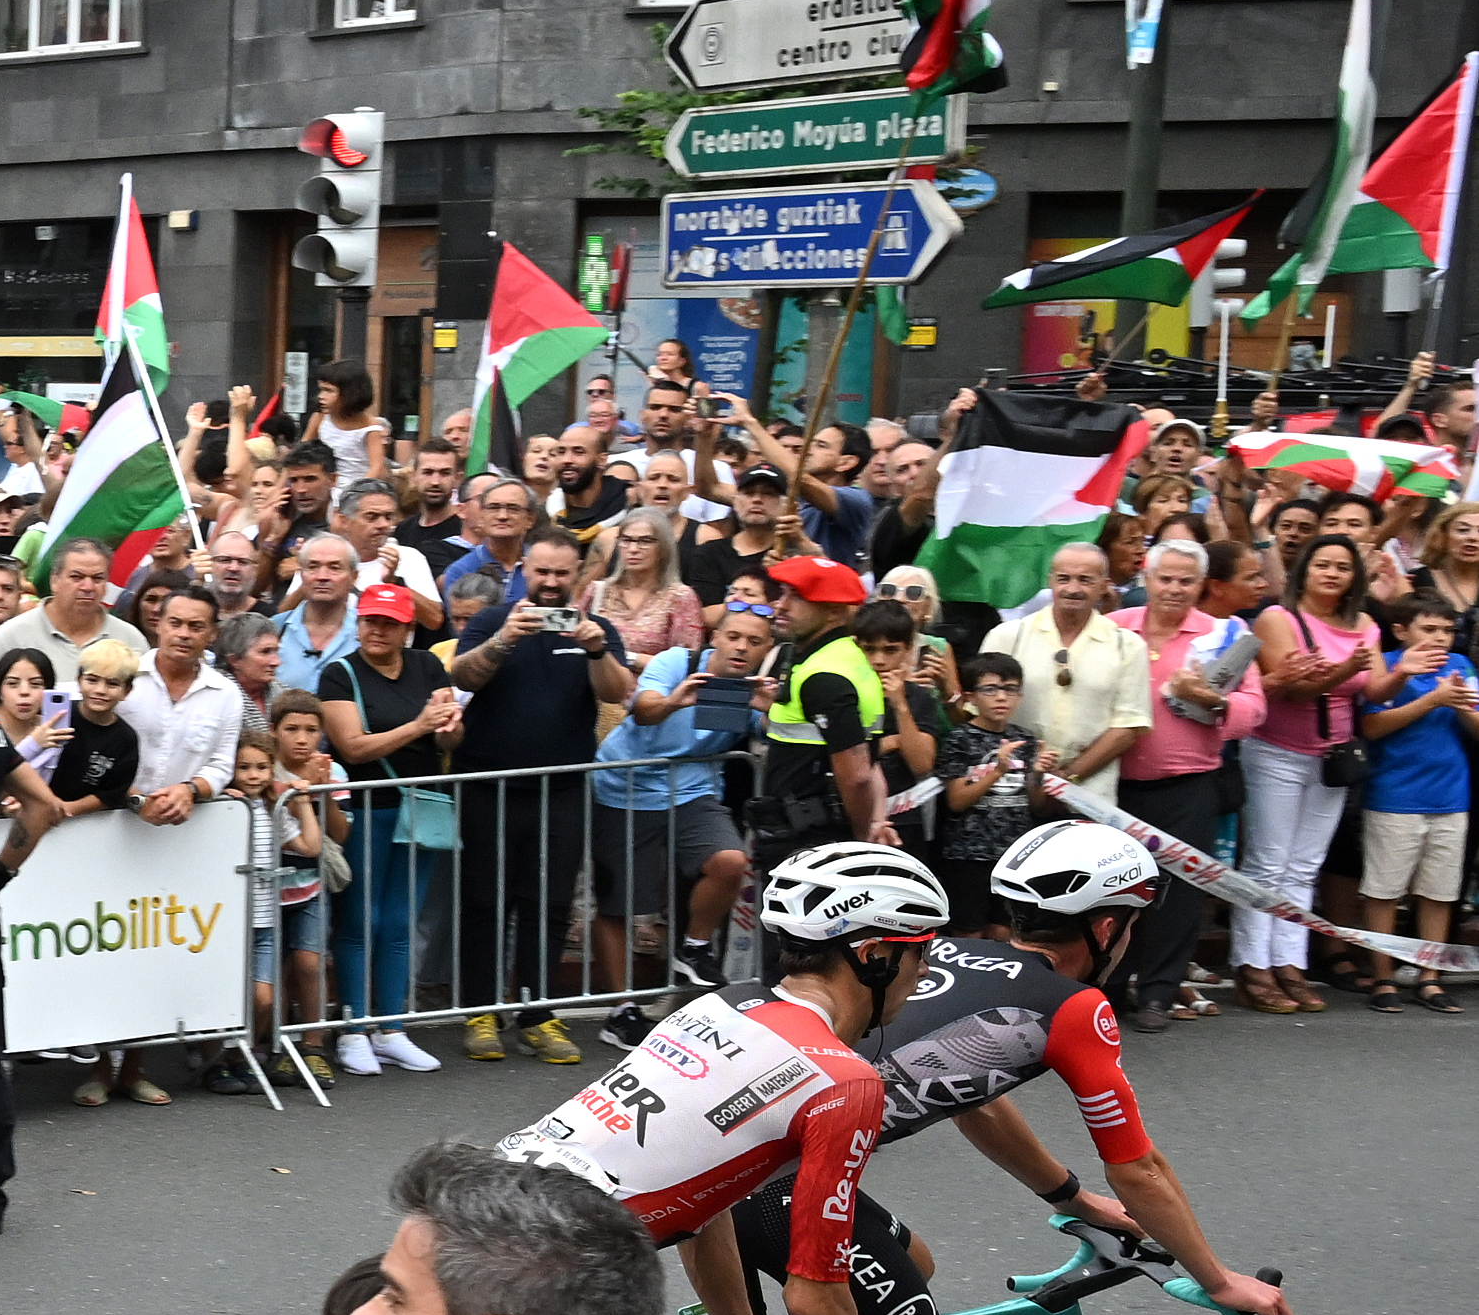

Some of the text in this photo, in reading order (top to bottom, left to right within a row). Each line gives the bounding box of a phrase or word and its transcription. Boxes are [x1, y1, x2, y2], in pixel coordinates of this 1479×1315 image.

[776, 29, 903, 67] centro ciu
[691, 112, 943, 155] Federico Moyúa plaza
[775, 198, 862, 233] guztiak
[1096, 852, 1125, 869] ARKEA
[823, 890, 875, 920] uvex
[711, 1060, 808, 1128] GOBERT MATERIAUX
[804, 1096, 847, 1119] VERGE
[880, 1069, 1021, 1132] RKEA
[638, 1204, 682, 1224] ODA
[849, 1243, 896, 1303] KEA
